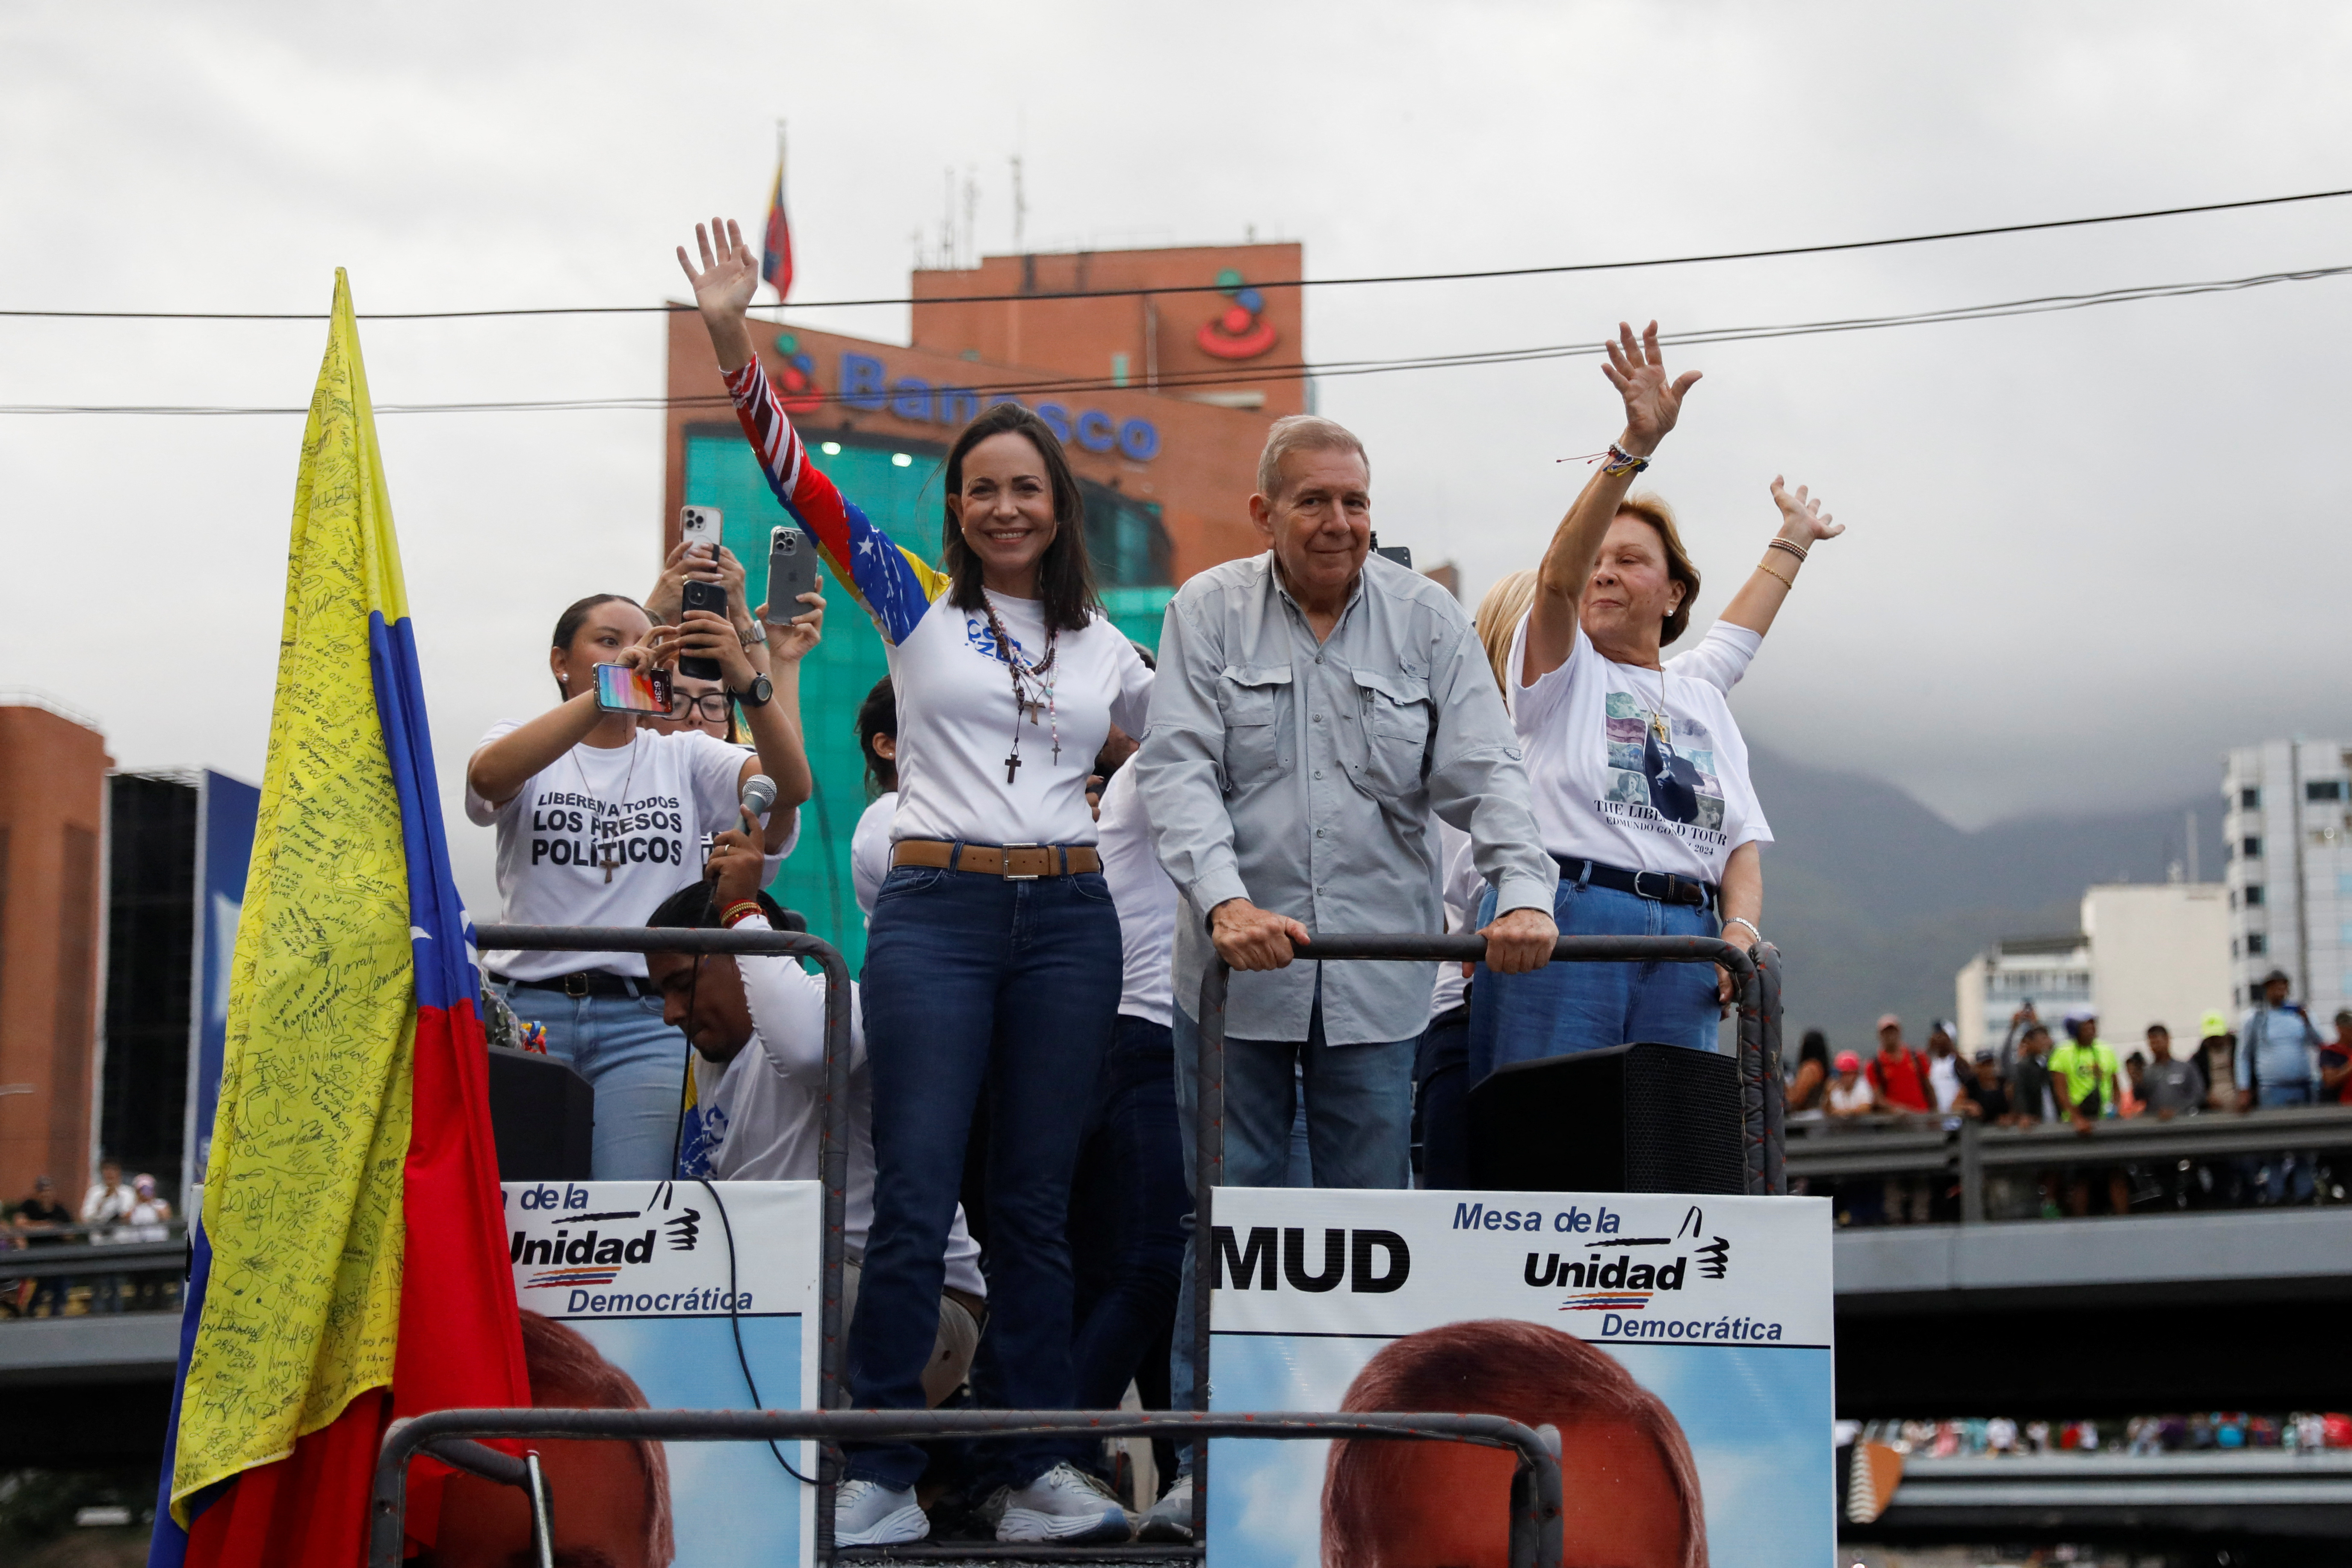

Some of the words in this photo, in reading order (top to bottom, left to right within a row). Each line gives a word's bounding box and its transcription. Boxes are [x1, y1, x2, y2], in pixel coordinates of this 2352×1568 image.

[538, 791, 606, 815] LIBEREN
[607, 803, 619, 817] A
[623, 796, 679, 814] TODOS
[533, 809, 582, 833] LOS
[591, 811, 682, 839] PRESOS
[1594, 800, 1623, 815] THE
[1690, 827, 1727, 846] TOUR
[1606, 817, 1654, 831] EDMUNDO
[1694, 844, 1714, 856] 2024
[532, 837, 682, 867] POLÍTICOS
[520, 1183, 559, 1211] de
[562, 1183, 589, 1210] la
[1453, 1202, 1542, 1231] Mesa
[1554, 1206, 1592, 1234] de
[1595, 1207, 1621, 1234] la
[1211, 1225, 1411, 1293] MUD
[1524, 1252, 1687, 1290] Unidad
[567, 1287, 753, 1313] Democrática
[1601, 1314, 1783, 1341] Democrática
